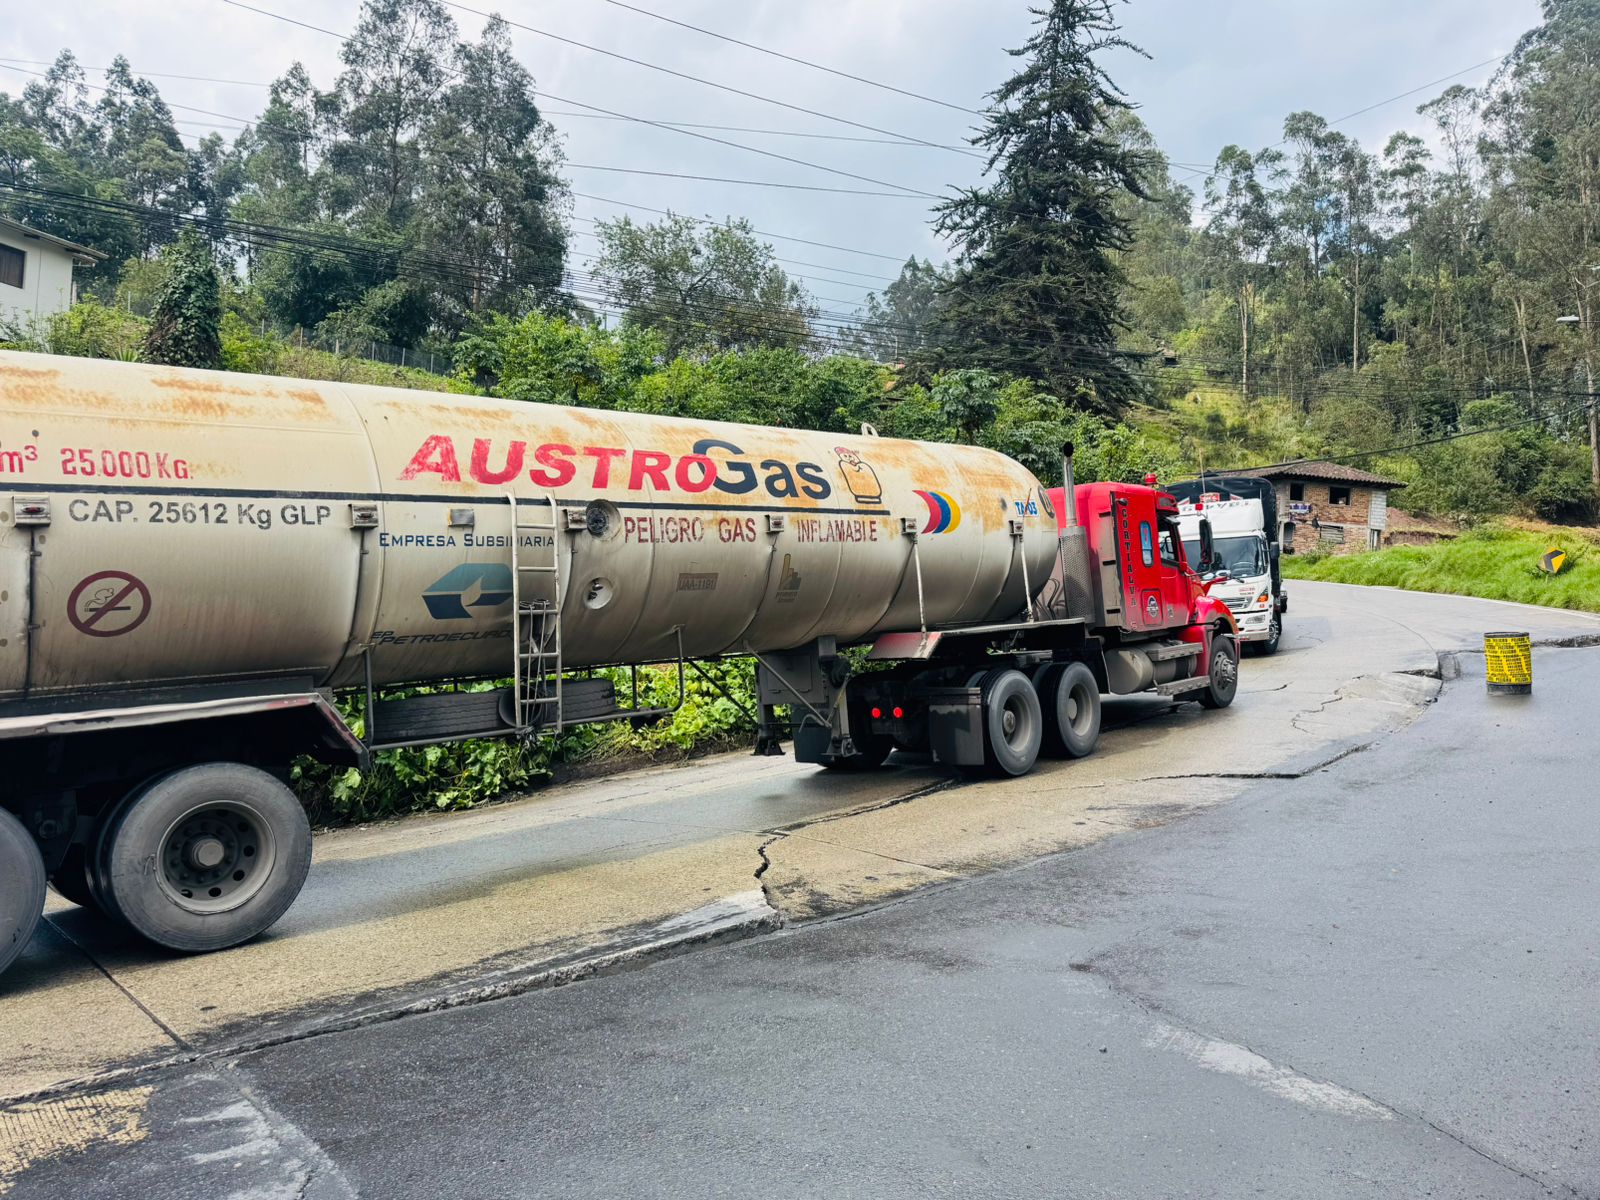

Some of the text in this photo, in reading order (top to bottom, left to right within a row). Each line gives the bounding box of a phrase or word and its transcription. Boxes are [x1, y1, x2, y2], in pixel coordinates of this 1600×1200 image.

[60, 448, 151, 478] 25.000
[69, 499, 332, 531] CAP. 25612 Kg GLP
[379, 532, 457, 547] EMPRESA
[624, 516, 705, 544] PELIGRO
[718, 517, 757, 543] GAS
[371, 630, 395, 640] EP
